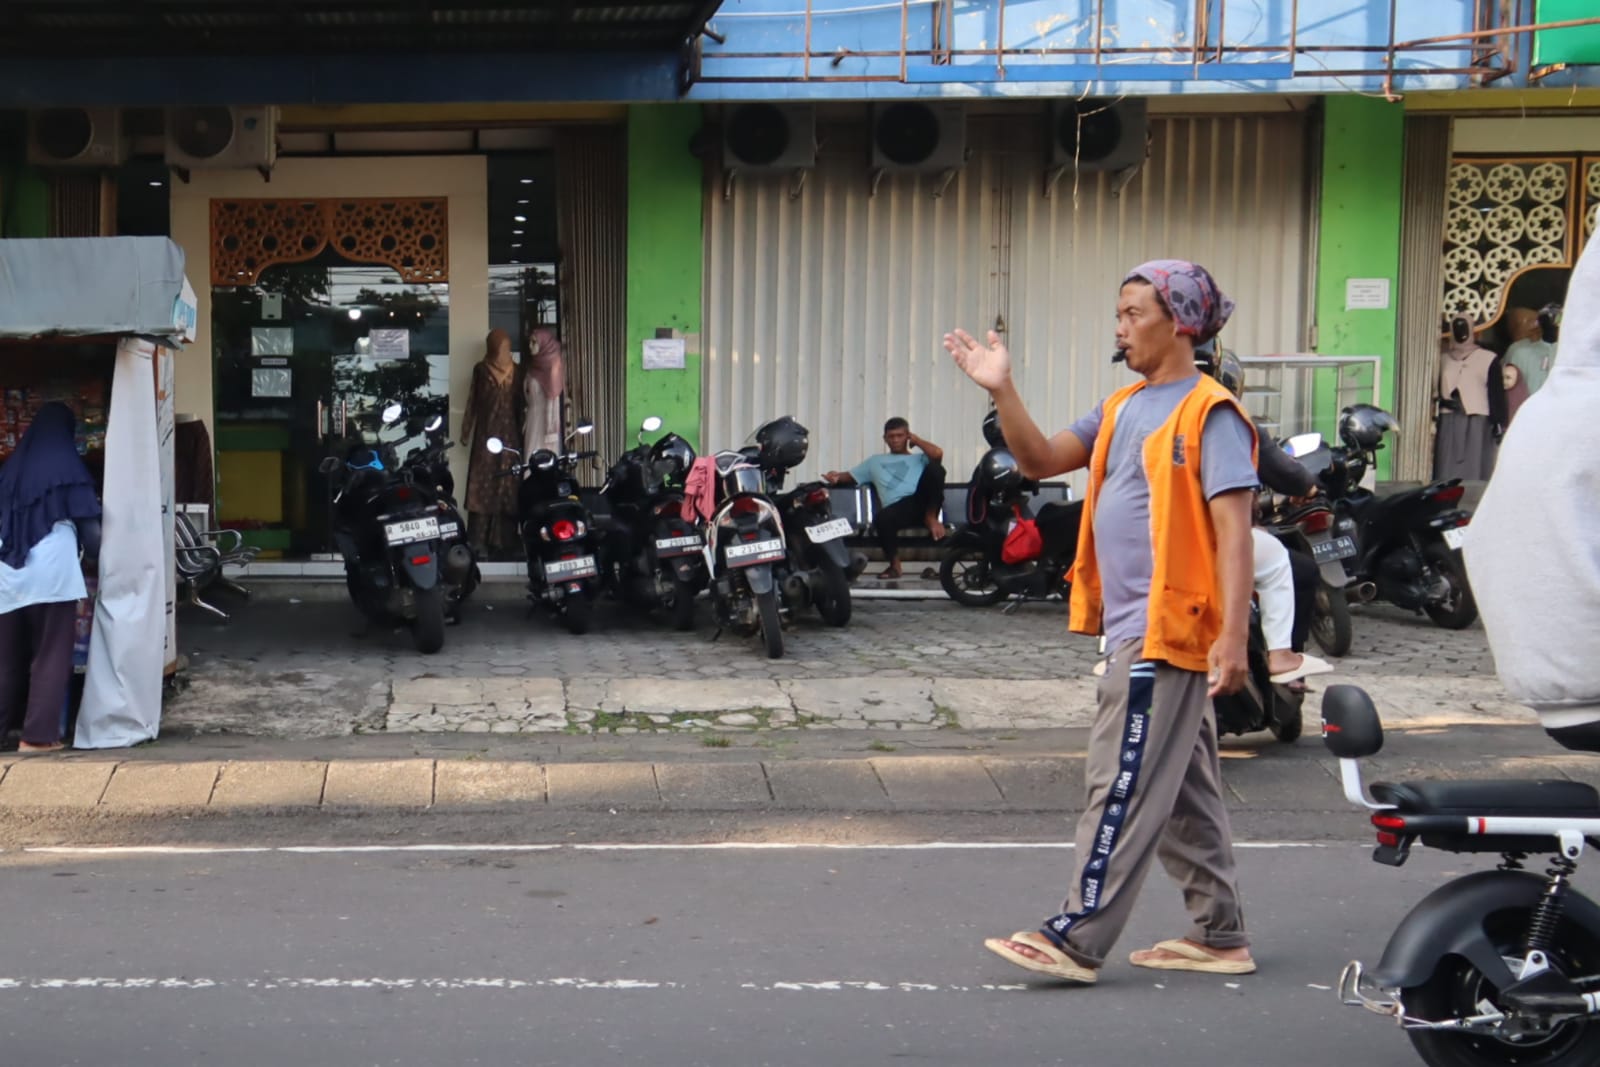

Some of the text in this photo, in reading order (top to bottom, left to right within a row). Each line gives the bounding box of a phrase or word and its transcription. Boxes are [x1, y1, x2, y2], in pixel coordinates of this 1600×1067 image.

[1128, 714, 1144, 743] SPORTS
[1097, 824, 1115, 855] SPORTS
[1083, 878, 1099, 907] SPORTS
